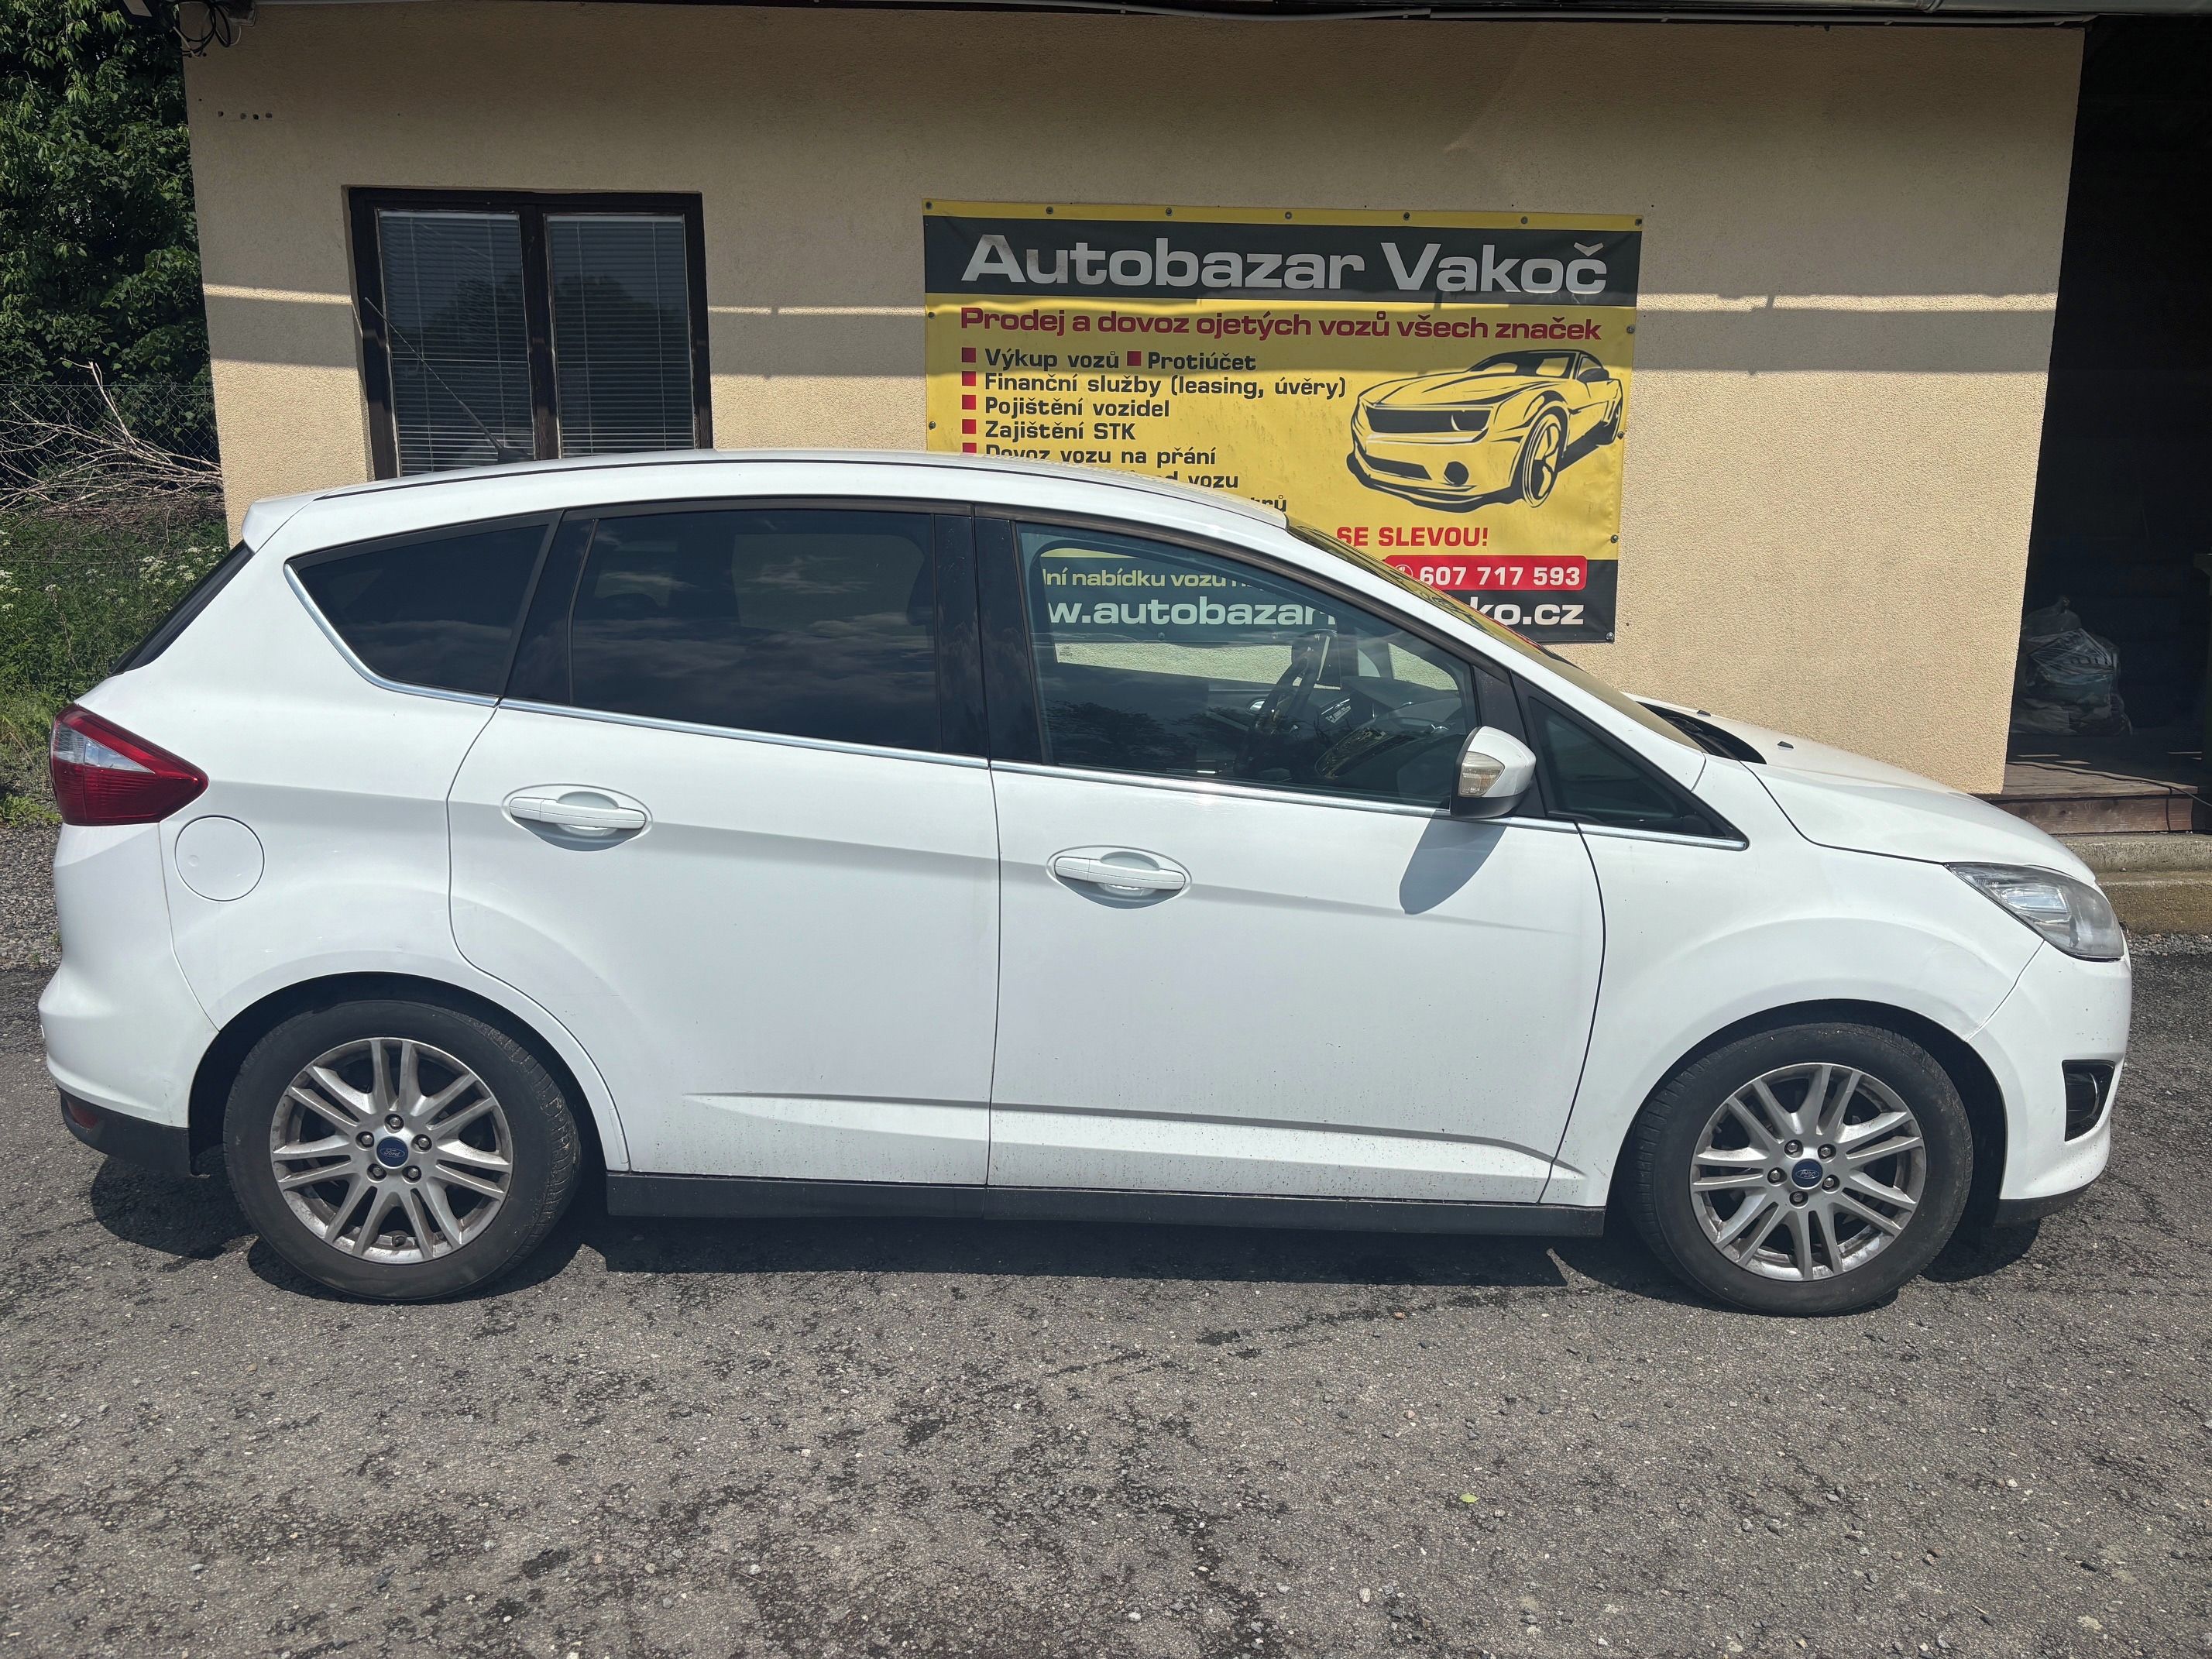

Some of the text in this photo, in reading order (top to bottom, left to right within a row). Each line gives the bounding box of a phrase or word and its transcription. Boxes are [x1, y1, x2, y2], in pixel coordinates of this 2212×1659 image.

[960, 234, 1608, 294] Autobazar Vakoč
[960, 307, 1602, 341] Prodej a dovoz ojetých vozů všech značek
[985, 348, 1257, 371] Výkup vozů Protiúčet
[985, 372, 1346, 400] Finanční služby (leasing, úvěry)
[985, 396, 1170, 418] Pojištění vozidel
[985, 419, 1136, 442] Zajištění STK
[1060, 450, 1111, 464] vozu
[1121, 451, 1147, 464] na
[1156, 447, 1217, 469] přání
[1187, 475, 1239, 489] vozu
[1337, 527, 1489, 547] SE SLEVOU!
[1072, 568, 1166, 587] nabídku
[1420, 566, 1581, 586] 607 717 593
[1048, 596, 1337, 625] w.autobazar
